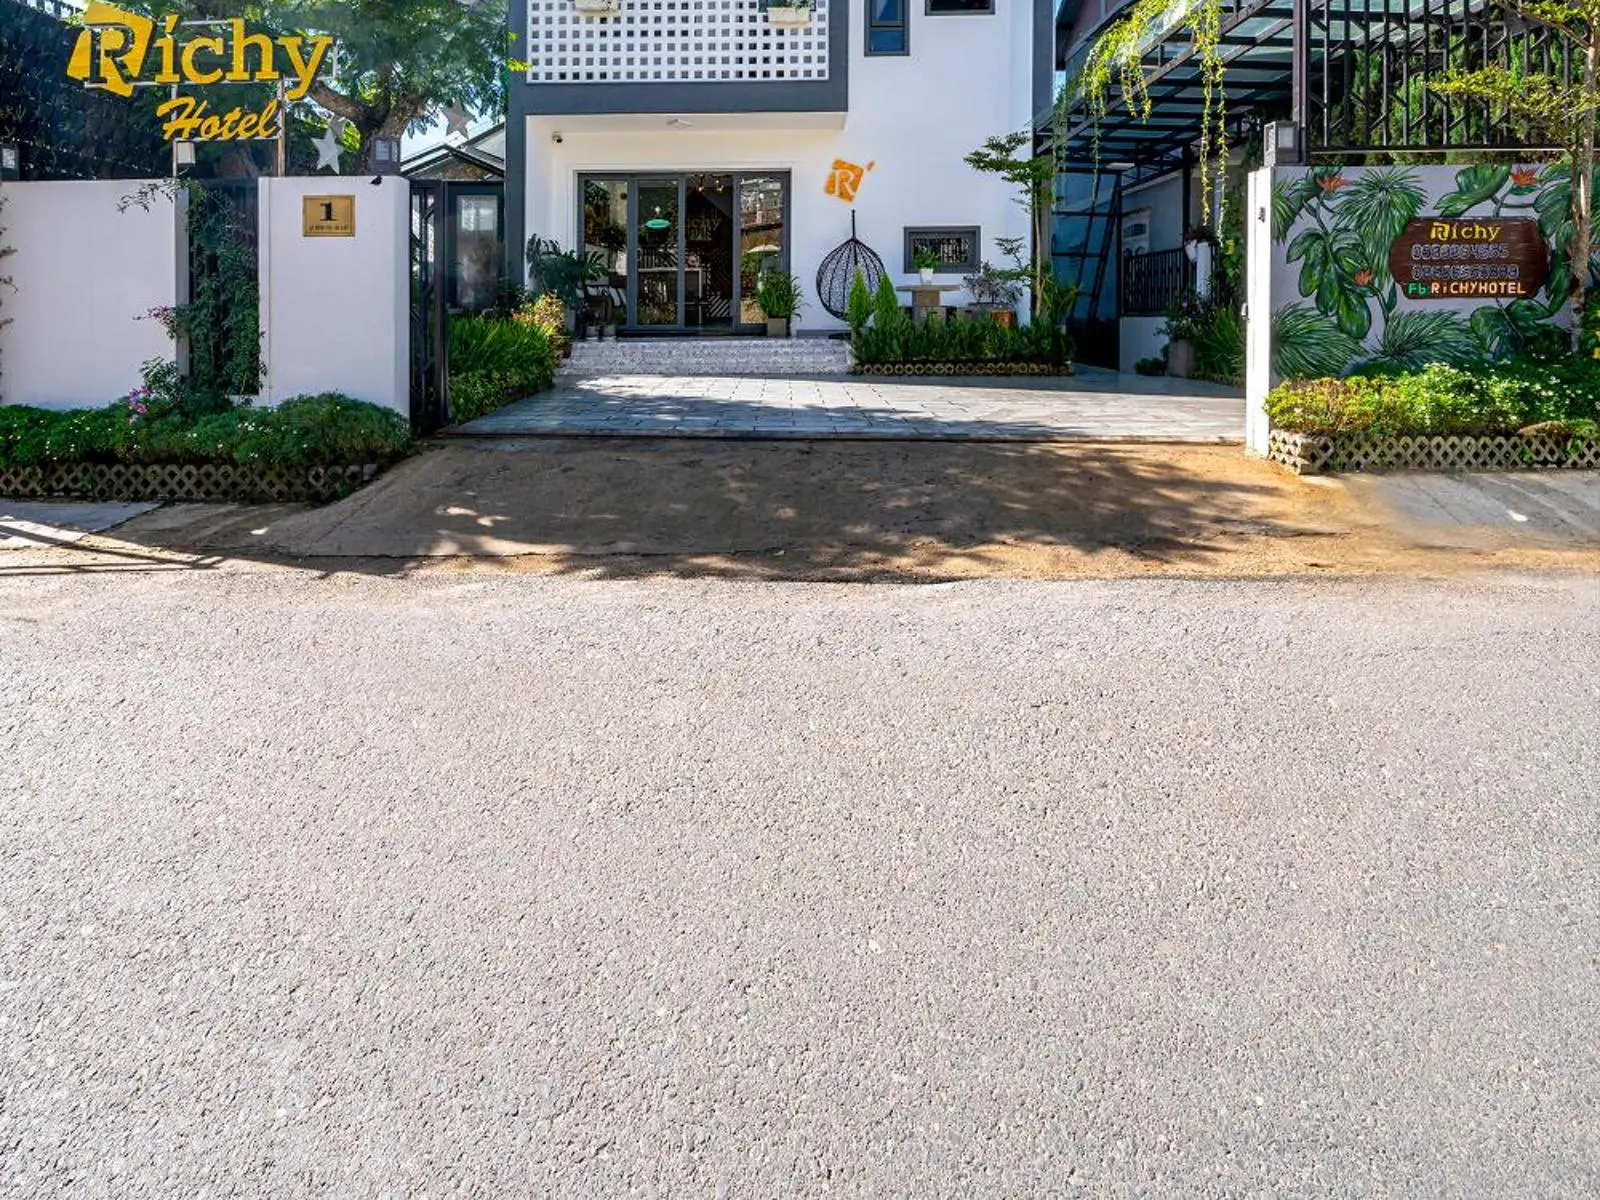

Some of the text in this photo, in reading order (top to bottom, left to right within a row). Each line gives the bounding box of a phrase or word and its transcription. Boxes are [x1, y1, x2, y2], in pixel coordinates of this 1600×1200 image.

[66, 0, 334, 101] Richy
[156, 96, 279, 141] Hotel
[319, 201, 337, 221] 1
[1430, 222, 1500, 241] Richy
[1408, 283, 1428, 295] Fb
